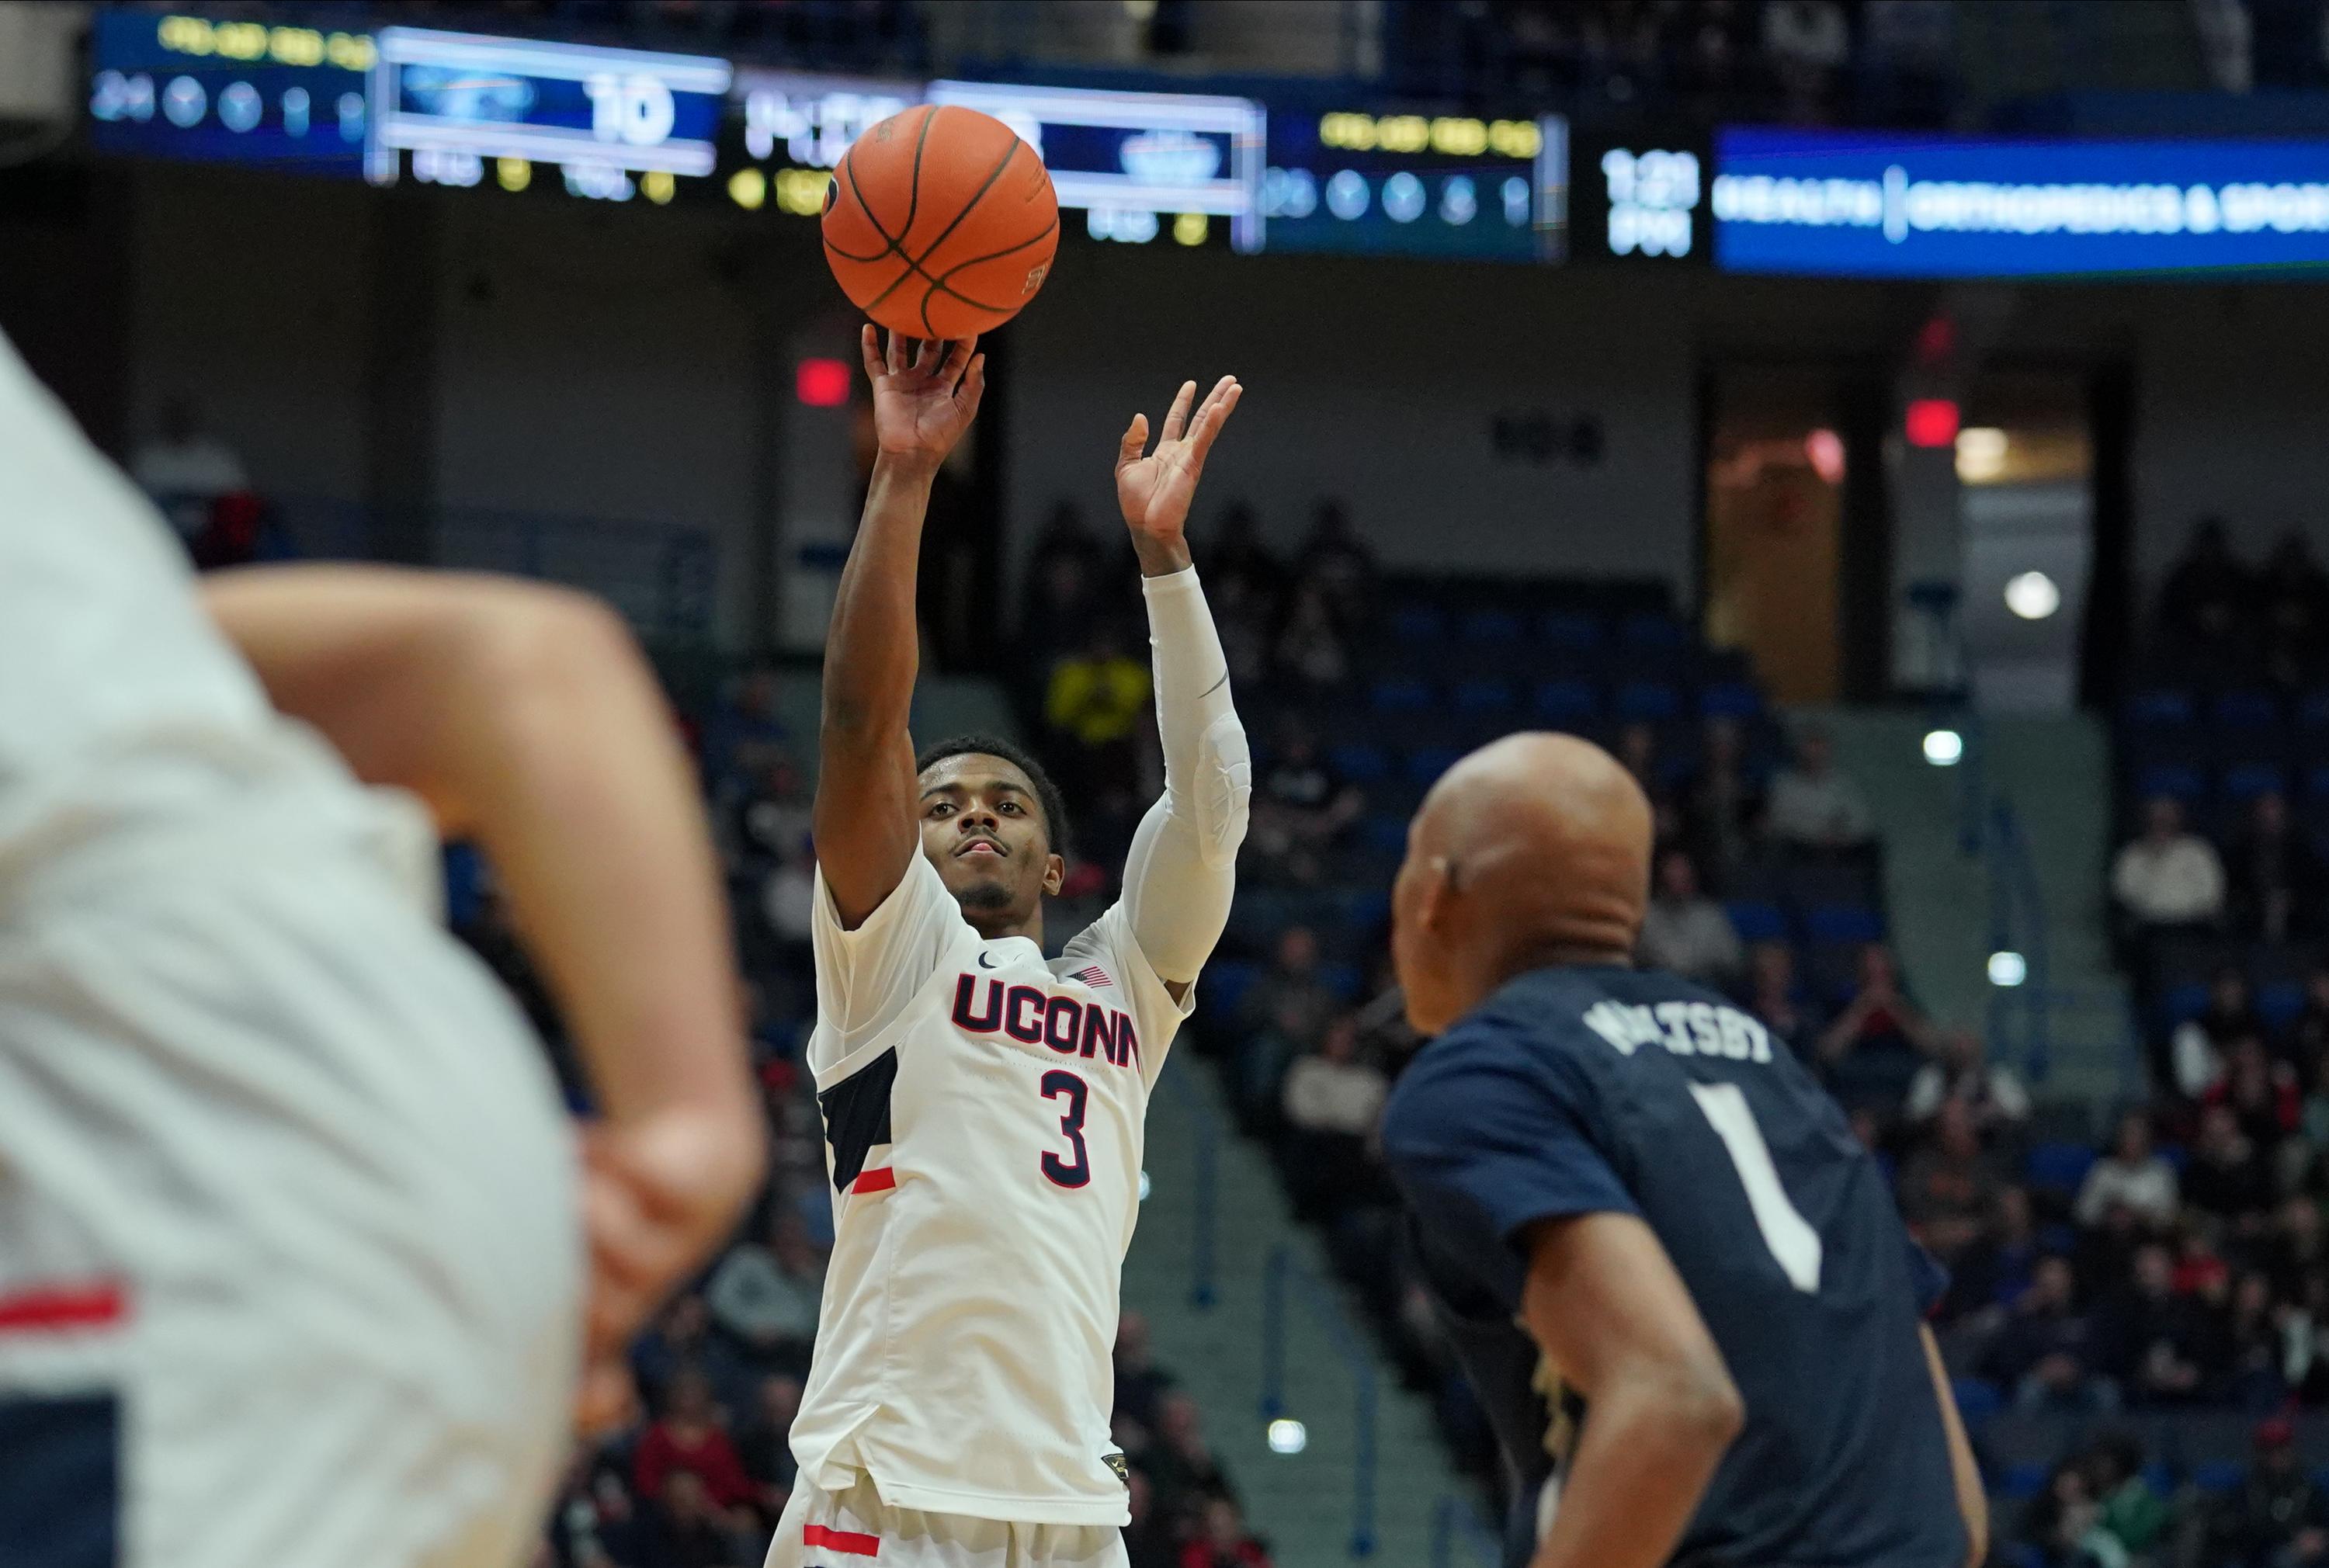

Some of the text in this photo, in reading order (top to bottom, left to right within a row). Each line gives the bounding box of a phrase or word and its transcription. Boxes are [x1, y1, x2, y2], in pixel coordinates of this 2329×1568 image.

[582, 70, 675, 146] 10
[1711, 174, 1883, 227] HEALTH
[1907, 180, 2184, 234] ORTHOPEDICS
[952, 972, 1140, 1074] UCONN
[1040, 1069, 1091, 1189] 3
[1686, 1082, 1823, 1295] 1
